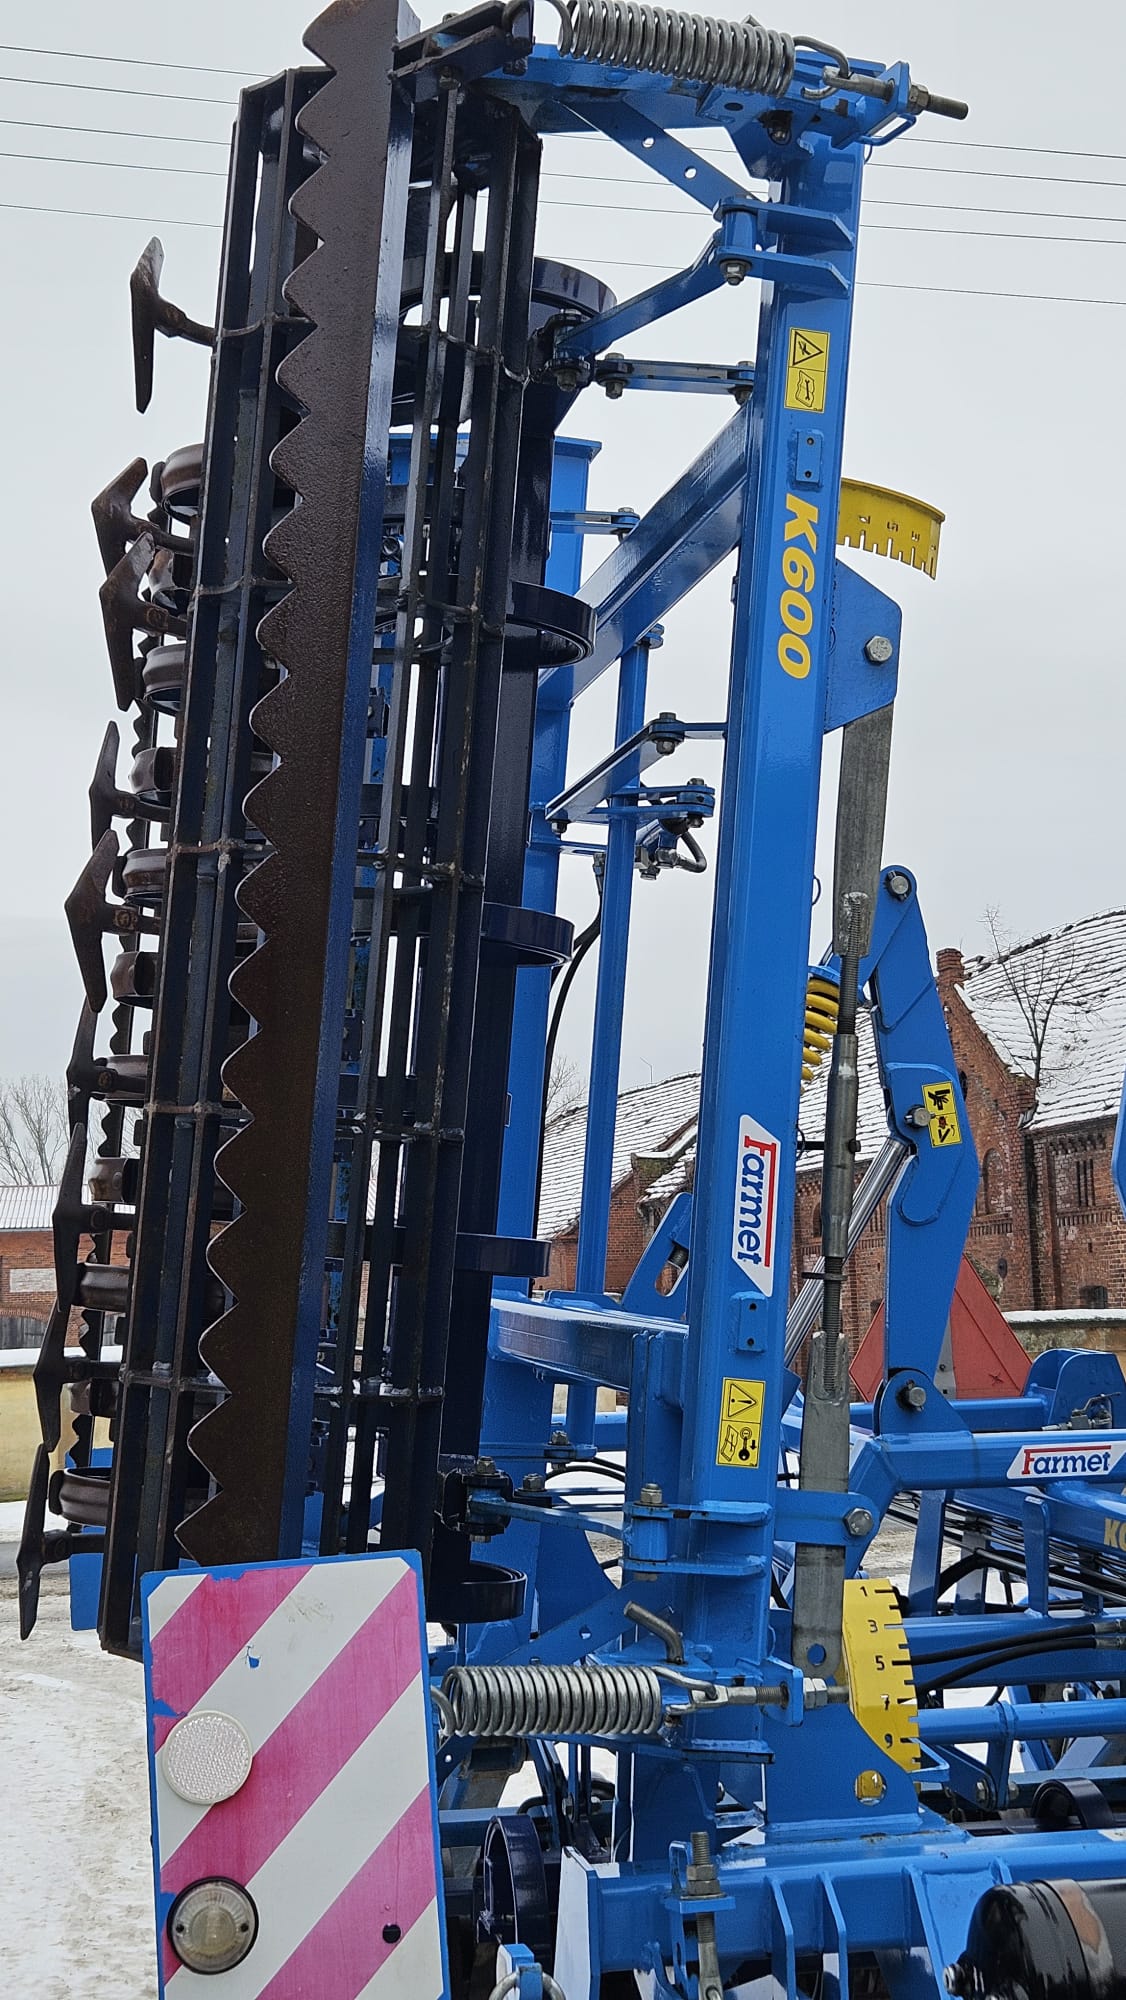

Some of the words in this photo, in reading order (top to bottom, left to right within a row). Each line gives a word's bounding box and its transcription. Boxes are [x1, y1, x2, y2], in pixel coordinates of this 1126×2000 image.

[778, 492, 819, 679] K600
[737, 1135, 777, 1268] Farmet
[1021, 1445, 1111, 1475] Farmet
[859, 1586, 868, 1597] 1
[867, 1619, 879, 1633] 3
[875, 1655, 885, 1671] 5
[880, 1694, 890, 1711] 7
[884, 1733, 893, 1749] 9
